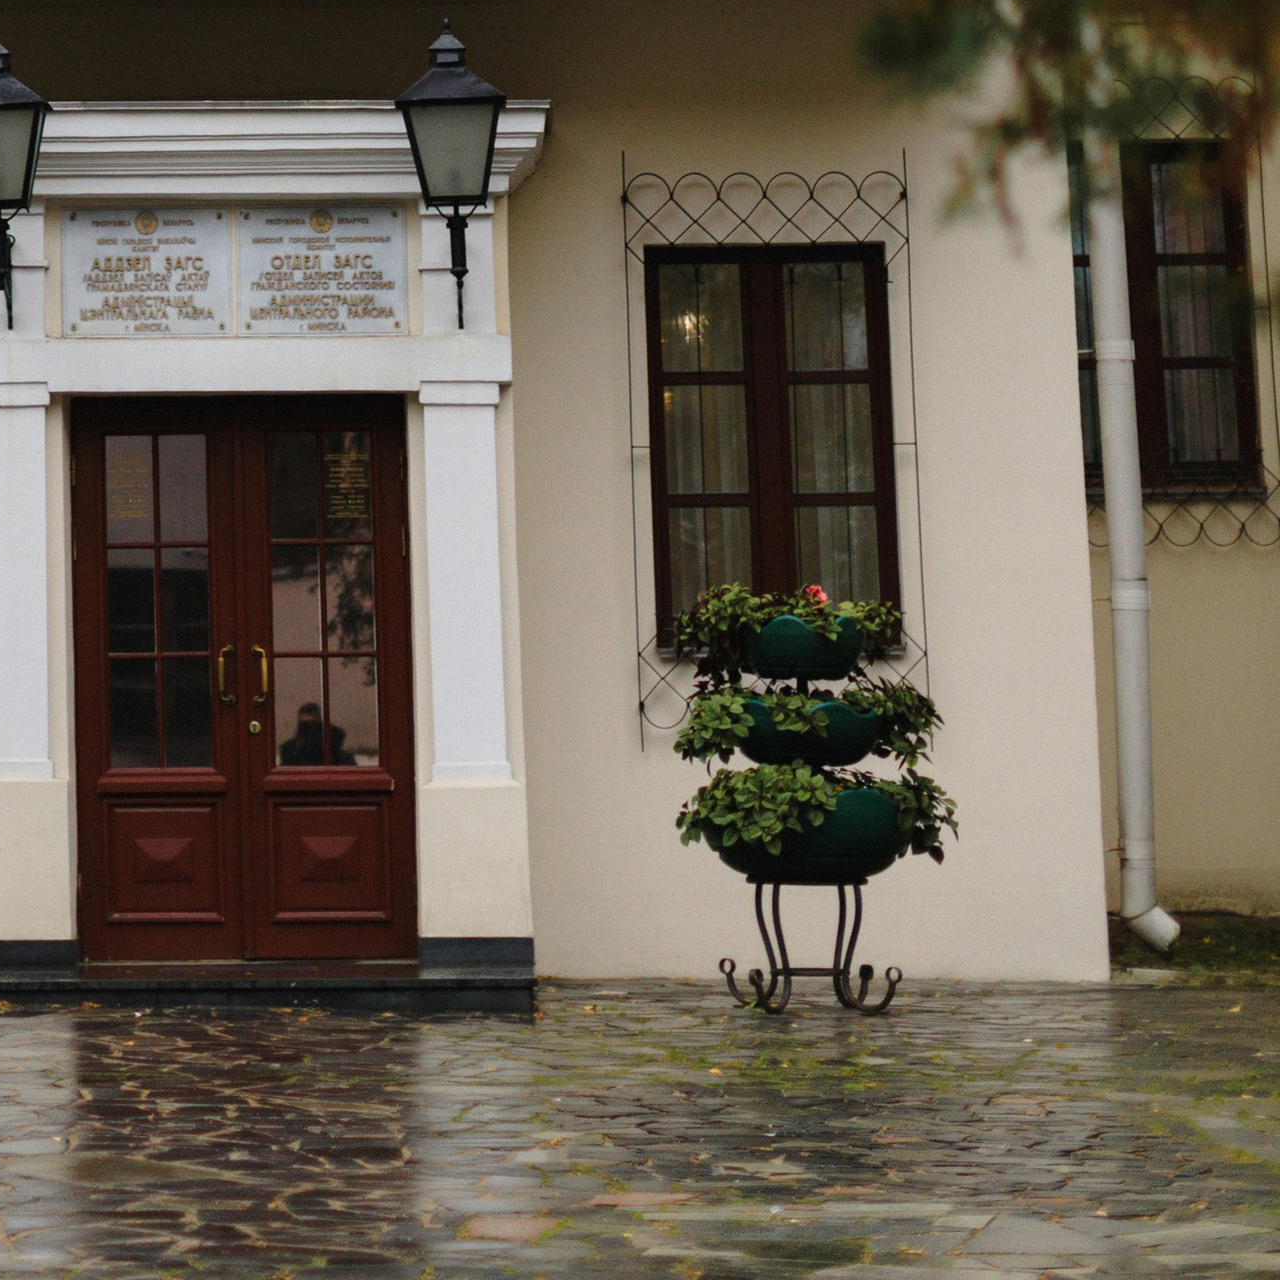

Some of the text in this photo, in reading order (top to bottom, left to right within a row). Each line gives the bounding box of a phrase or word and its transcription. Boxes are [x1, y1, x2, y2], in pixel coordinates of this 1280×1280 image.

[91, 255, 204, 272] АДДЗЕЛ ЗАГС
[270, 254, 373, 271] ОТДЕЛ ЗАГС
[180, 270, 210, 282] АКТАЎ
[302, 271, 344, 281] ЗАПИСЕЙ
[352, 271, 383, 281] АКТОВ
[251, 282, 330, 292] ГРАЖДАНСКОГО
[269, 294, 375, 308] АДМИНИСТРАЦИИ
[250, 306, 396, 321] ЦЕНТРАЛЬНОГО РАЙОНА
[307, 322, 347, 331] МИНСКА
